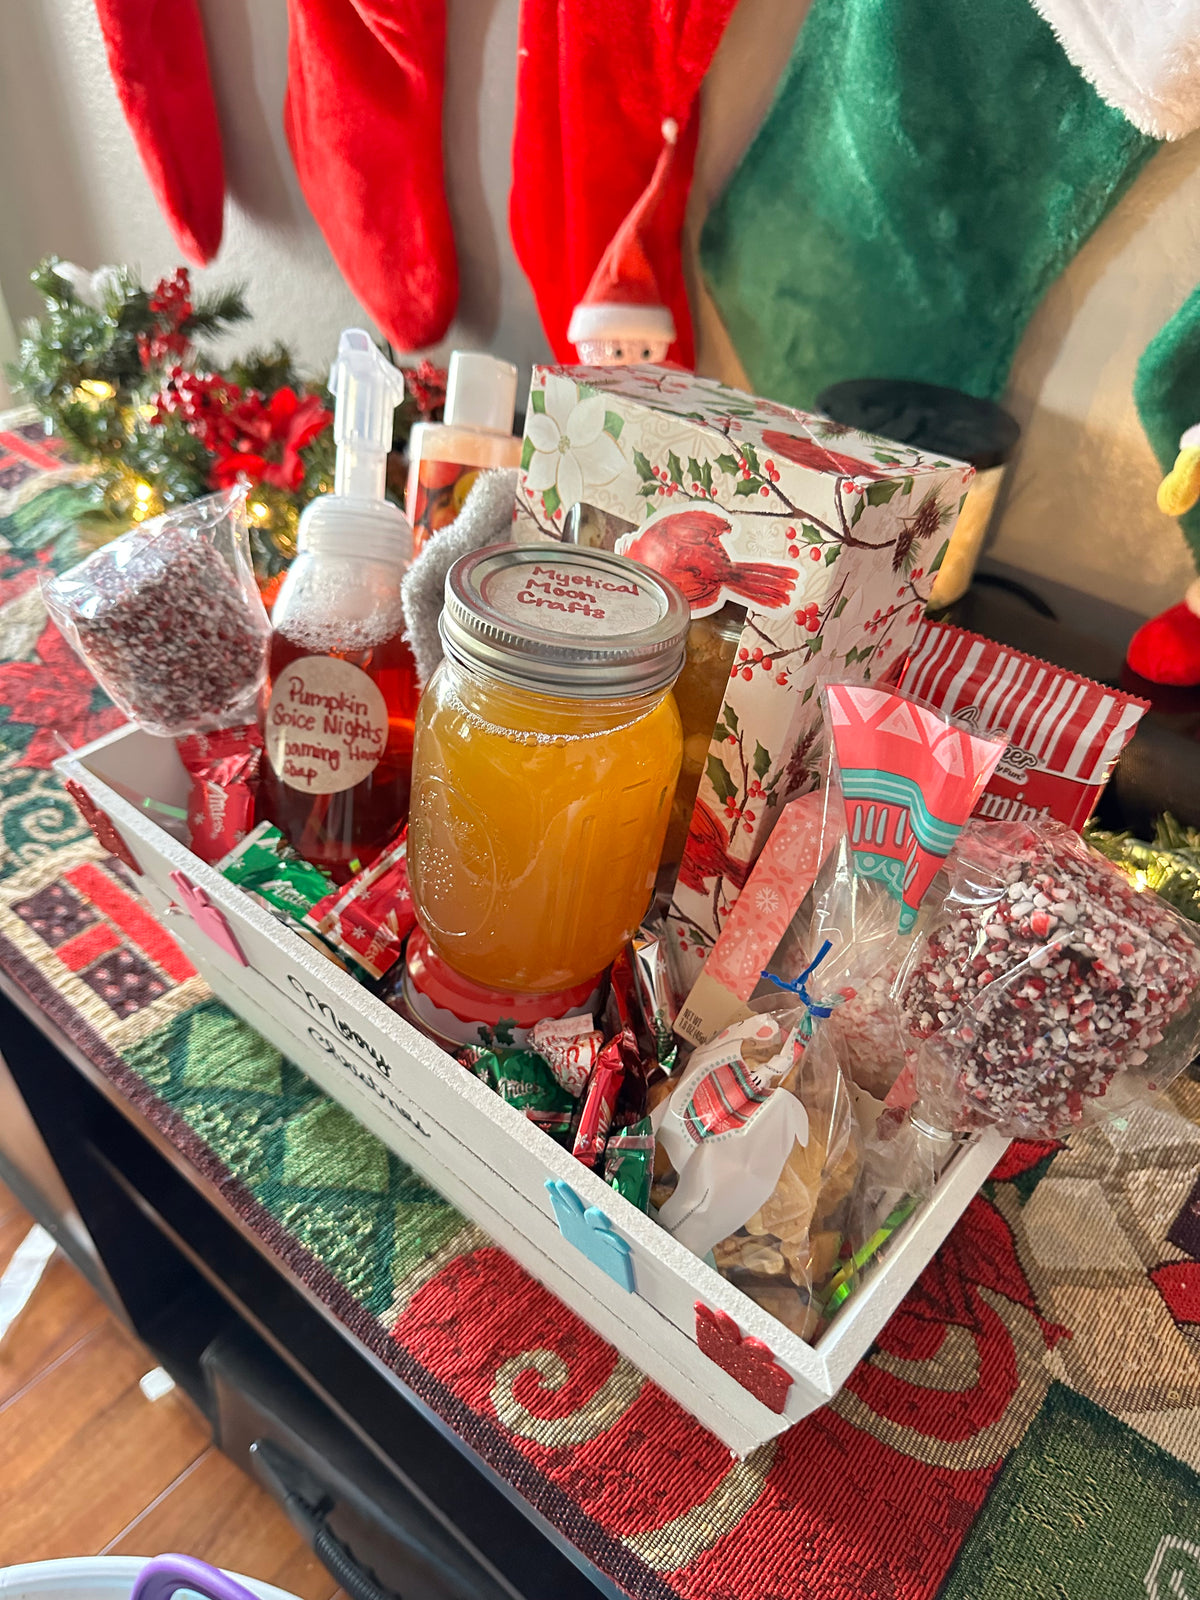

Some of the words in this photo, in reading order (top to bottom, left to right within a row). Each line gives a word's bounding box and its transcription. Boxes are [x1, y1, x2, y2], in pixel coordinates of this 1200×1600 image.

[525, 579, 597, 604] Moon
[532, 566, 640, 597] Mystical
[517, 590, 606, 619] Crafts
[288, 676, 369, 716] Pumpkin
[323, 715, 384, 745] Nights
[274, 736, 342, 771] oaming
[283, 759, 318, 787] Soap
[979, 791, 1051, 823] mint
[287, 974, 392, 1078] Merry
[308, 1026, 432, 1138] Christmas
